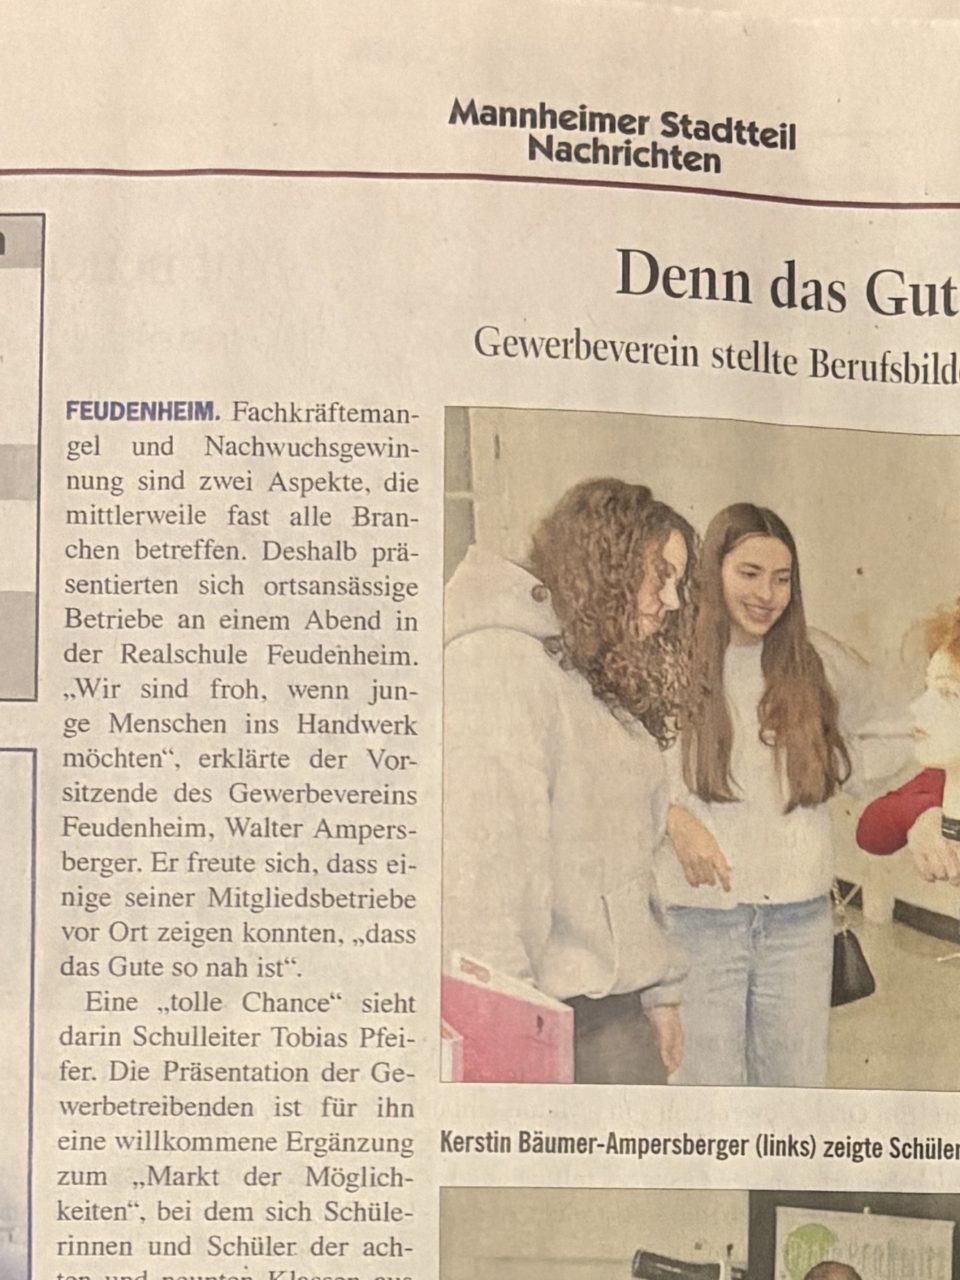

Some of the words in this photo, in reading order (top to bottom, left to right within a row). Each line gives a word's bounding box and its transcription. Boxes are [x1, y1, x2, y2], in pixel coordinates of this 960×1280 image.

[447, 97, 651, 136] Mannheimer
[659, 110, 797, 151] Stadtteil
[528, 132, 722, 174] Nachrichten
[615, 248, 753, 305] Denn
[770, 259, 847, 314] das
[474, 325, 699, 368] Gewerbeverein
[711, 339, 798, 377] stellte
[66, 399, 221, 422] FEUDENHEIM.
[232, 400, 420, 424] Fachkräfteman-
[66, 434, 101, 462] gel
[132, 434, 174, 457] und
[204, 434, 420, 465] Nachwuchsgewin-
[66, 475, 124, 497] nung
[137, 469, 185, 491] sind
[199, 469, 253, 492] zwei
[267, 470, 371, 499] Aspekte,
[383, 471, 419, 493] die
[61, 815, 215, 839] Feudenheim,
[224, 816, 304, 839] Walter
[313, 818, 417, 846] Ampers-
[58, 1024, 121, 1047] darin
[132, 1025, 262, 1048] Schulleiter
[270, 1026, 348, 1048] Tobias
[359, 1026, 416, 1049] Pfei-
[57, 1129, 107, 1151] eine
[114, 1129, 278, 1152] willkommene
[286, 1130, 414, 1159] Ergänzung
[440, 1129, 512, 1154] Kerstin
[518, 1130, 750, 1161] Bäumer-Ampersberger
[755, 1133, 817, 1160] (links)
[822, 1135, 884, 1164] zeigte
